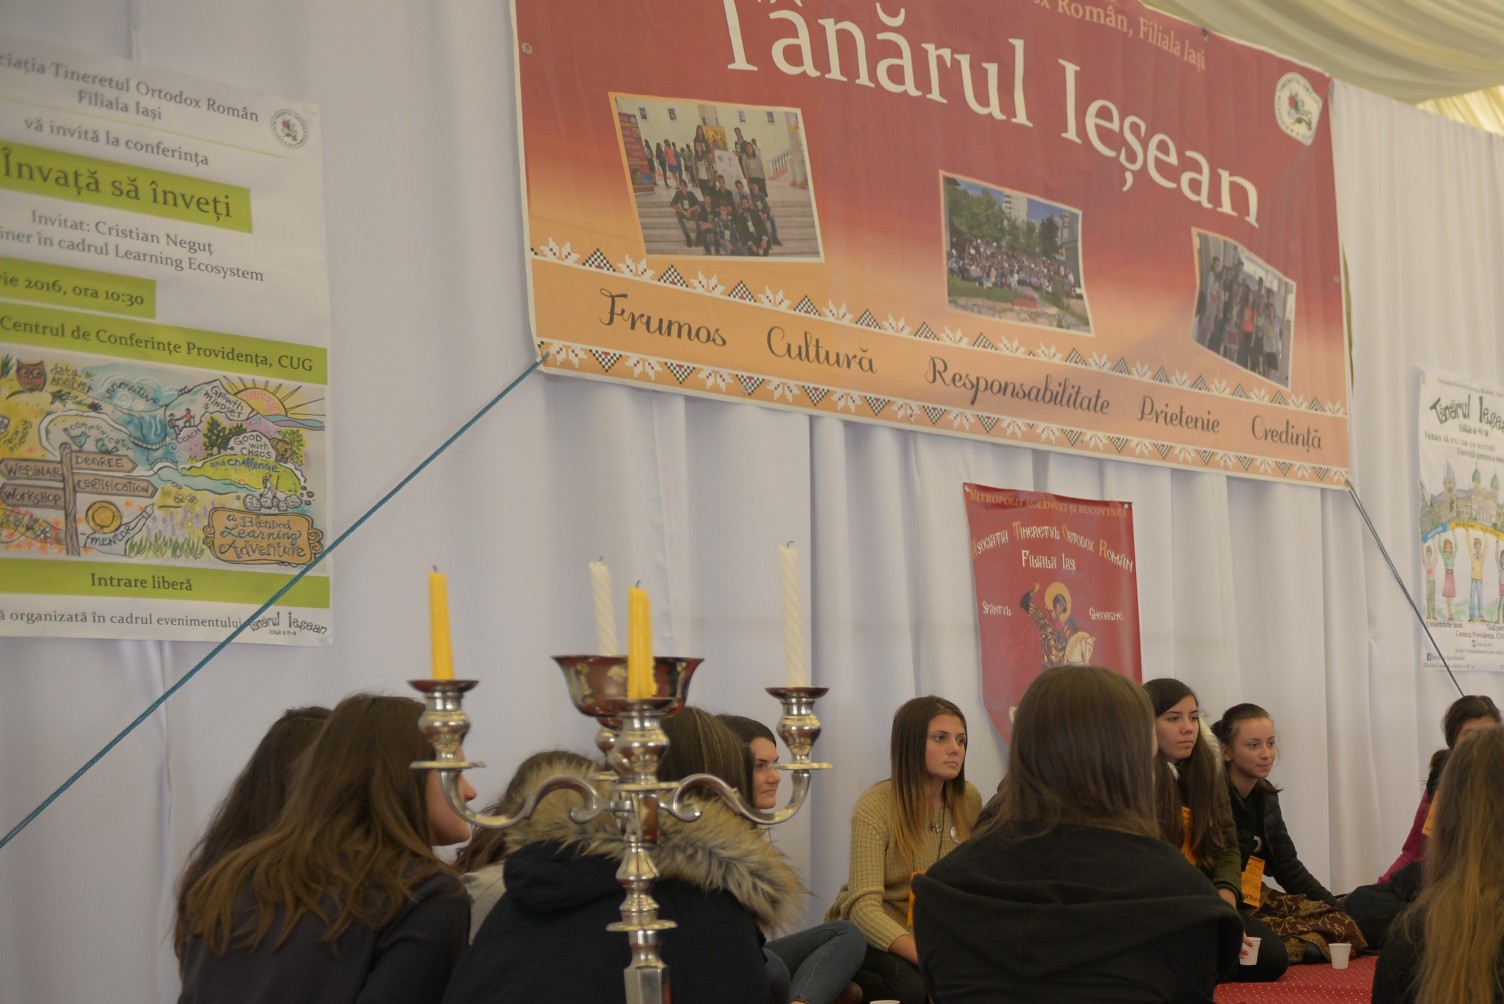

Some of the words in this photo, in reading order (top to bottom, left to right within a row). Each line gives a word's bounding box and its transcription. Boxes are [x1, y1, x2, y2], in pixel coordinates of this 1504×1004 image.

[1139, 17, 1181, 57] Filiala
[1184, 40, 1206, 72] Iași
[51, 62, 131, 92] Tineretul
[136, 81, 202, 109] Ortodox
[207, 97, 259, 122] Român
[78, 90, 129, 113] Filiala
[135, 101, 162, 122] Iași
[24, 119, 43, 132] vă
[50, 120, 100, 143] invită
[105, 131, 120, 148] la
[125, 138, 209, 167] conferința
[1058, 58, 1259, 228] Ieșean
[2, 148, 101, 196] Învață
[111, 176, 141, 201] să
[149, 180, 232, 222] înveți
[32, 210, 91, 232] Invitat:
[95, 221, 161, 244] Cristian
[166, 233, 213, 257] Neguț
[36, 231, 53, 247] în
[58, 238, 109, 256] cadrul
[115, 244, 184, 271] Learning
[188, 257, 264, 282] Ecosystem
[25, 279, 67, 296] 2016,
[73, 285, 99, 298] ora
[104, 290, 144, 306] 10:30
[0, 316, 65, 337] Centrul
[71, 326, 90, 341] de
[96, 329, 181, 355] Conferințe
[187, 342, 272, 368] Providența,
[278, 355, 313, 372] CUG
[600, 288, 727, 347] Frumos
[767, 326, 877, 374] Cultură
[925, 356, 1110, 416] Responsabilitate
[1135, 394, 1220, 434] Prietenie
[1251, 414, 1323, 453] Credință
[91, 572, 148, 589] Intrare
[152, 575, 193, 591] liberă
[9, 610, 88, 625] organizată
[91, 612, 106, 624] în
[110, 613, 153, 625] cadrul
[156, 614, 242, 628] evenimentului
